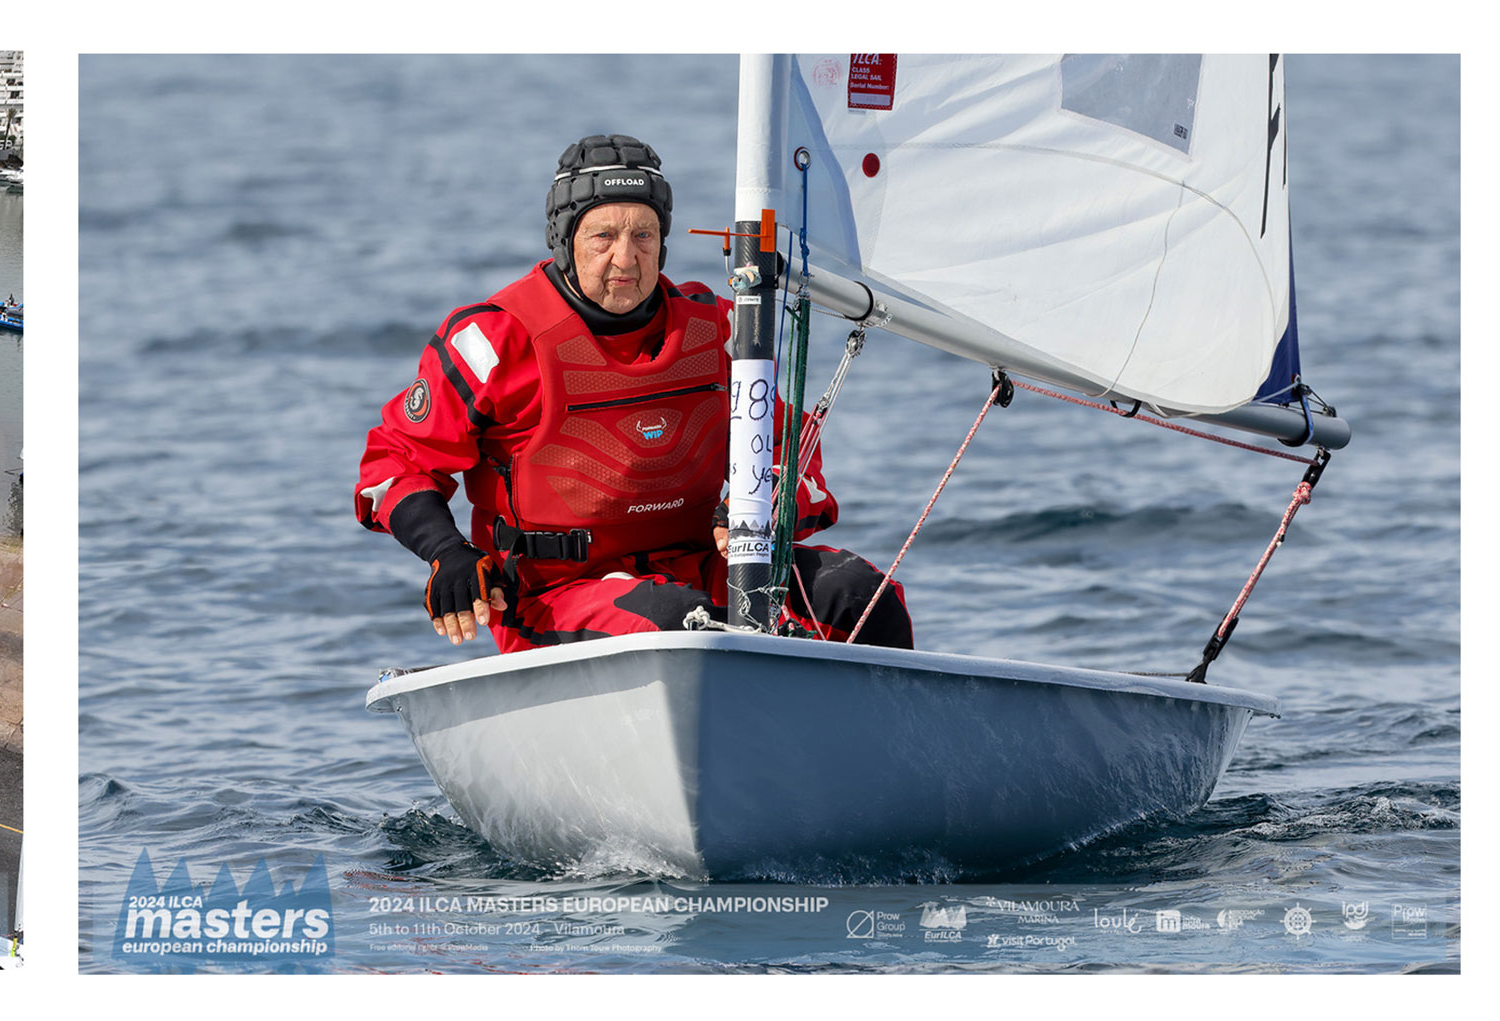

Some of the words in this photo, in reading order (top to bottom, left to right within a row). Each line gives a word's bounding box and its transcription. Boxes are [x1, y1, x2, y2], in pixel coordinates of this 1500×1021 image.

[604, 178, 645, 186] OFFLOAD
[643, 429, 663, 440] WIP
[627, 498, 685, 514] FORWARD
